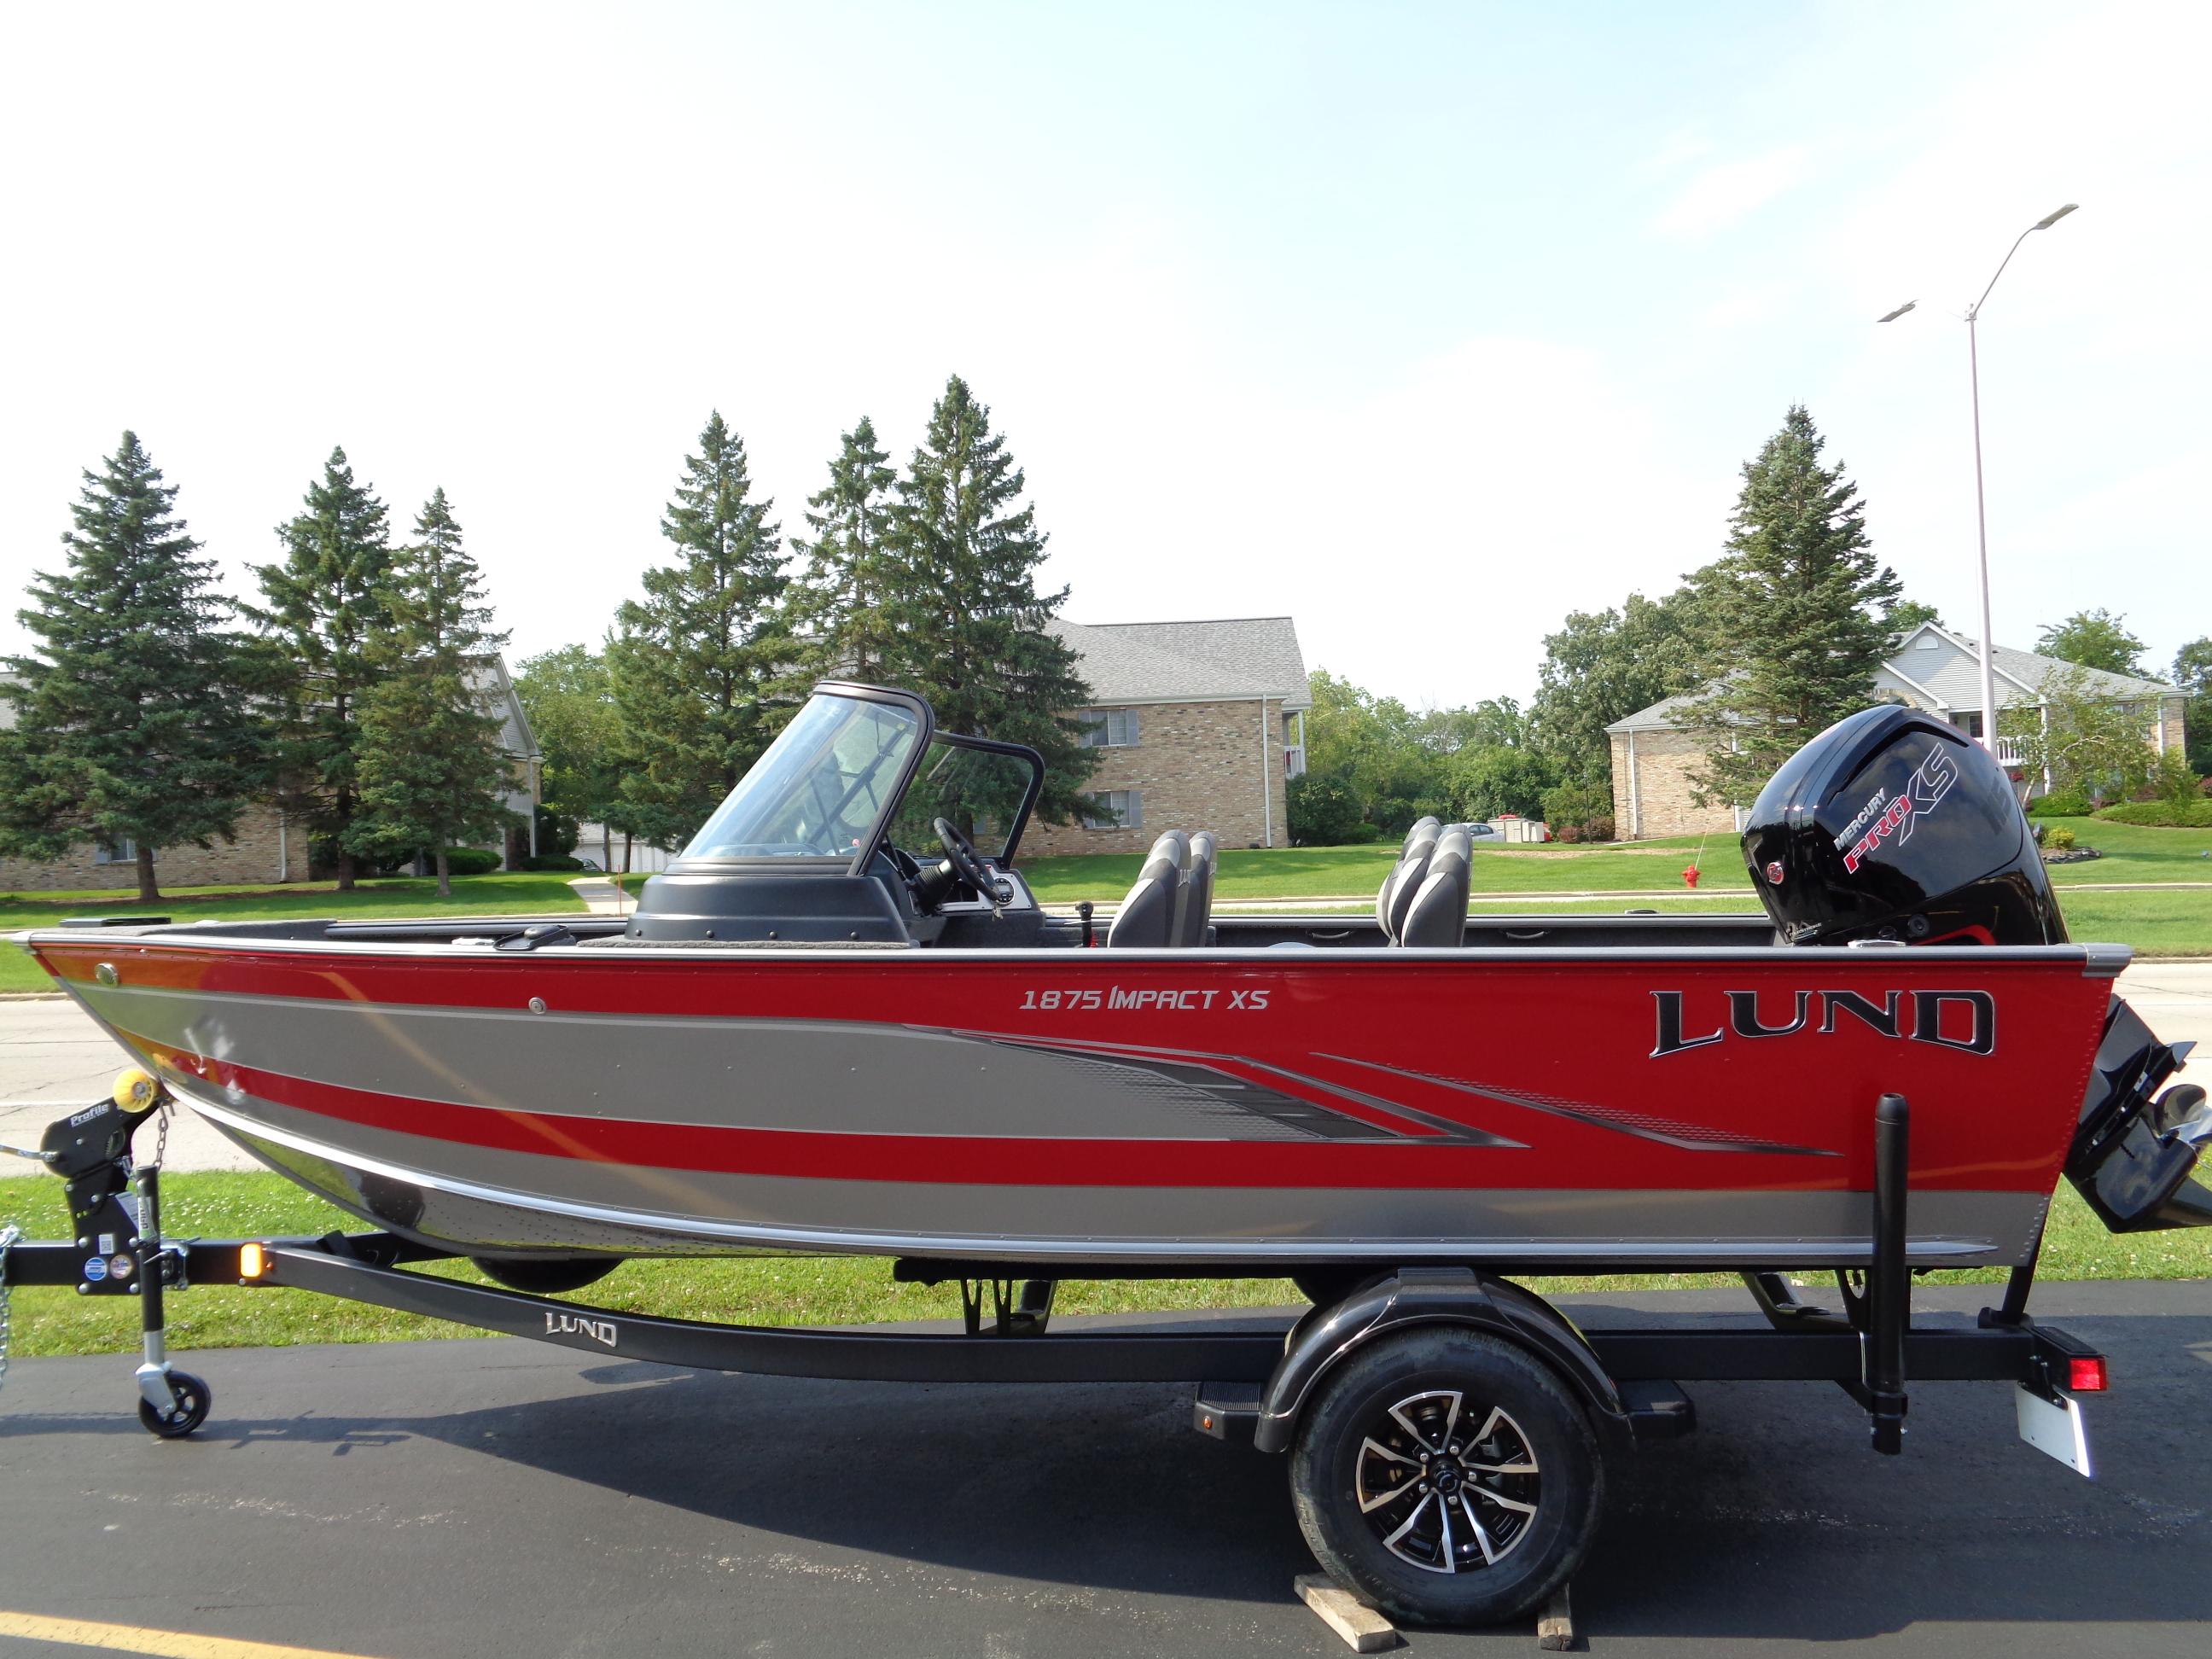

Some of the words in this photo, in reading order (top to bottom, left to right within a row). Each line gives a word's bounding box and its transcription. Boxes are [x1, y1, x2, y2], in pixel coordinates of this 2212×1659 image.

[1832, 787, 1887, 852] MERCURY
[1842, 794, 1912, 876] PRO
[1019, 990, 1103, 1010] 1875
[1107, 985, 1220, 1010] IMPACT
[1226, 990, 1271, 1010] XS
[1649, 989, 1996, 1058] LUND
[70, 1103, 109, 1126] Profile
[544, 1313, 617, 1348] LUND
